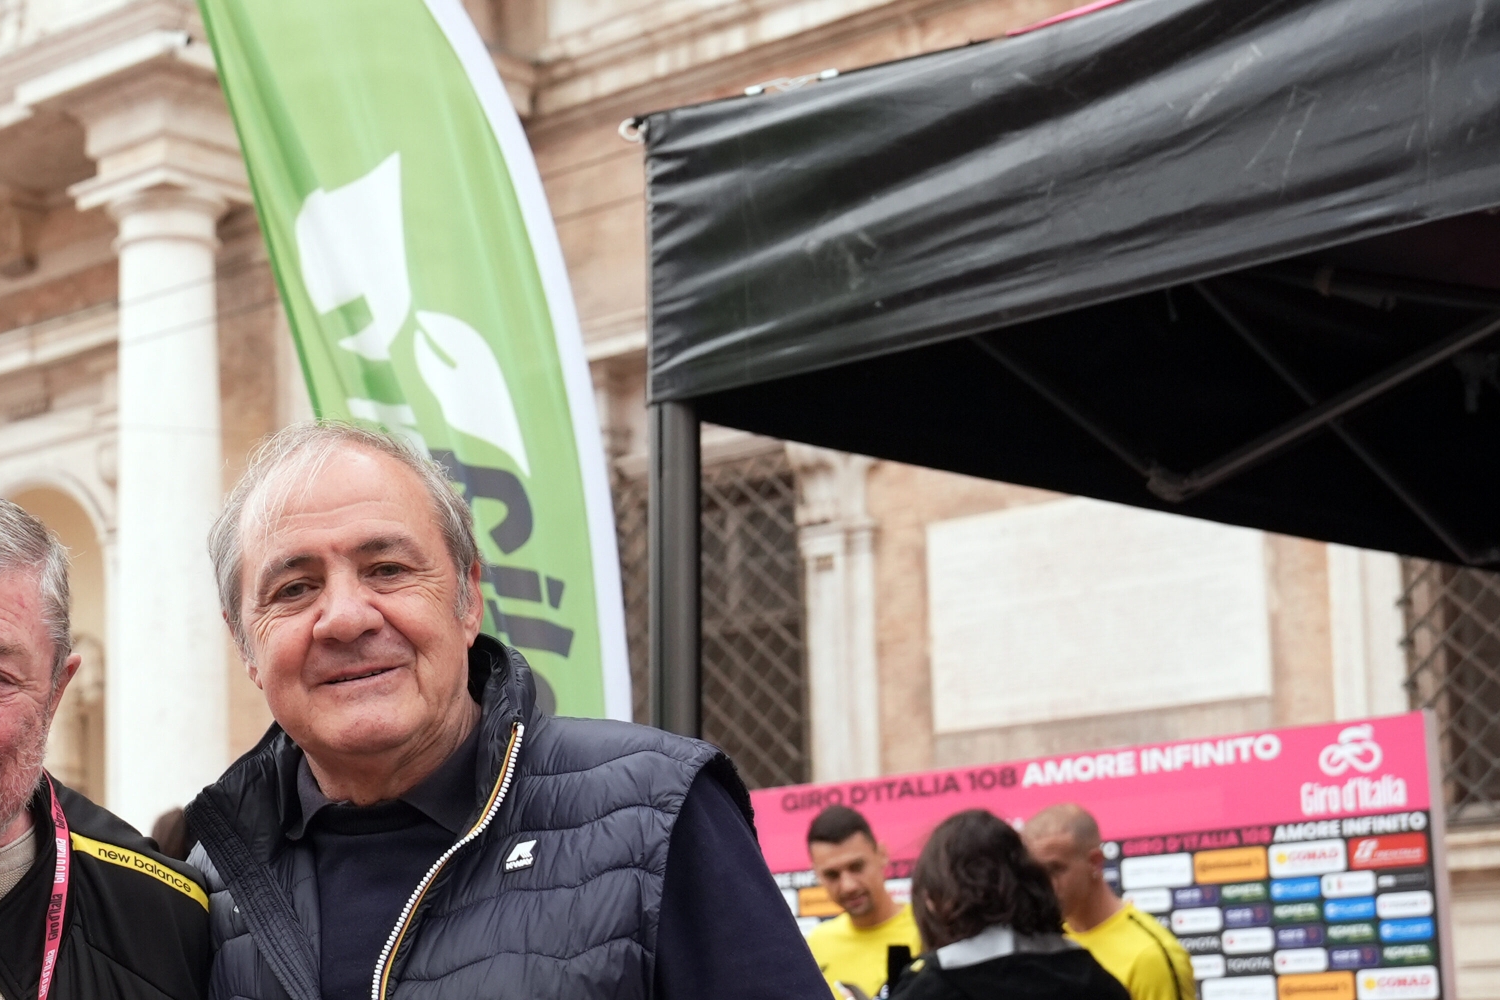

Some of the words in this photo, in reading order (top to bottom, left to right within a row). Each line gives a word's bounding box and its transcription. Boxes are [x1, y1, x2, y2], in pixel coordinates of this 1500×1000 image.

[782, 786, 843, 813] GIRO
[851, 770, 960, 805] D'ITALIA
[965, 765, 1018, 794] 108
[1022, 750, 1137, 788] AMORE
[1140, 733, 1281, 773] INFINITO
[1300, 780, 1342, 816] Giro
[1342, 773, 1407, 811] d'Italia
[1273, 818, 1341, 843] AMORE
[1342, 810, 1427, 838] INFINITO
[98, 847, 131, 864] new
[133, 855, 192, 893] balance
[48, 893, 64, 922] d'Italia
[47, 921, 60, 942] Giro
[41, 948, 56, 980] d'Italia
[39, 978, 50, 998] Giro
